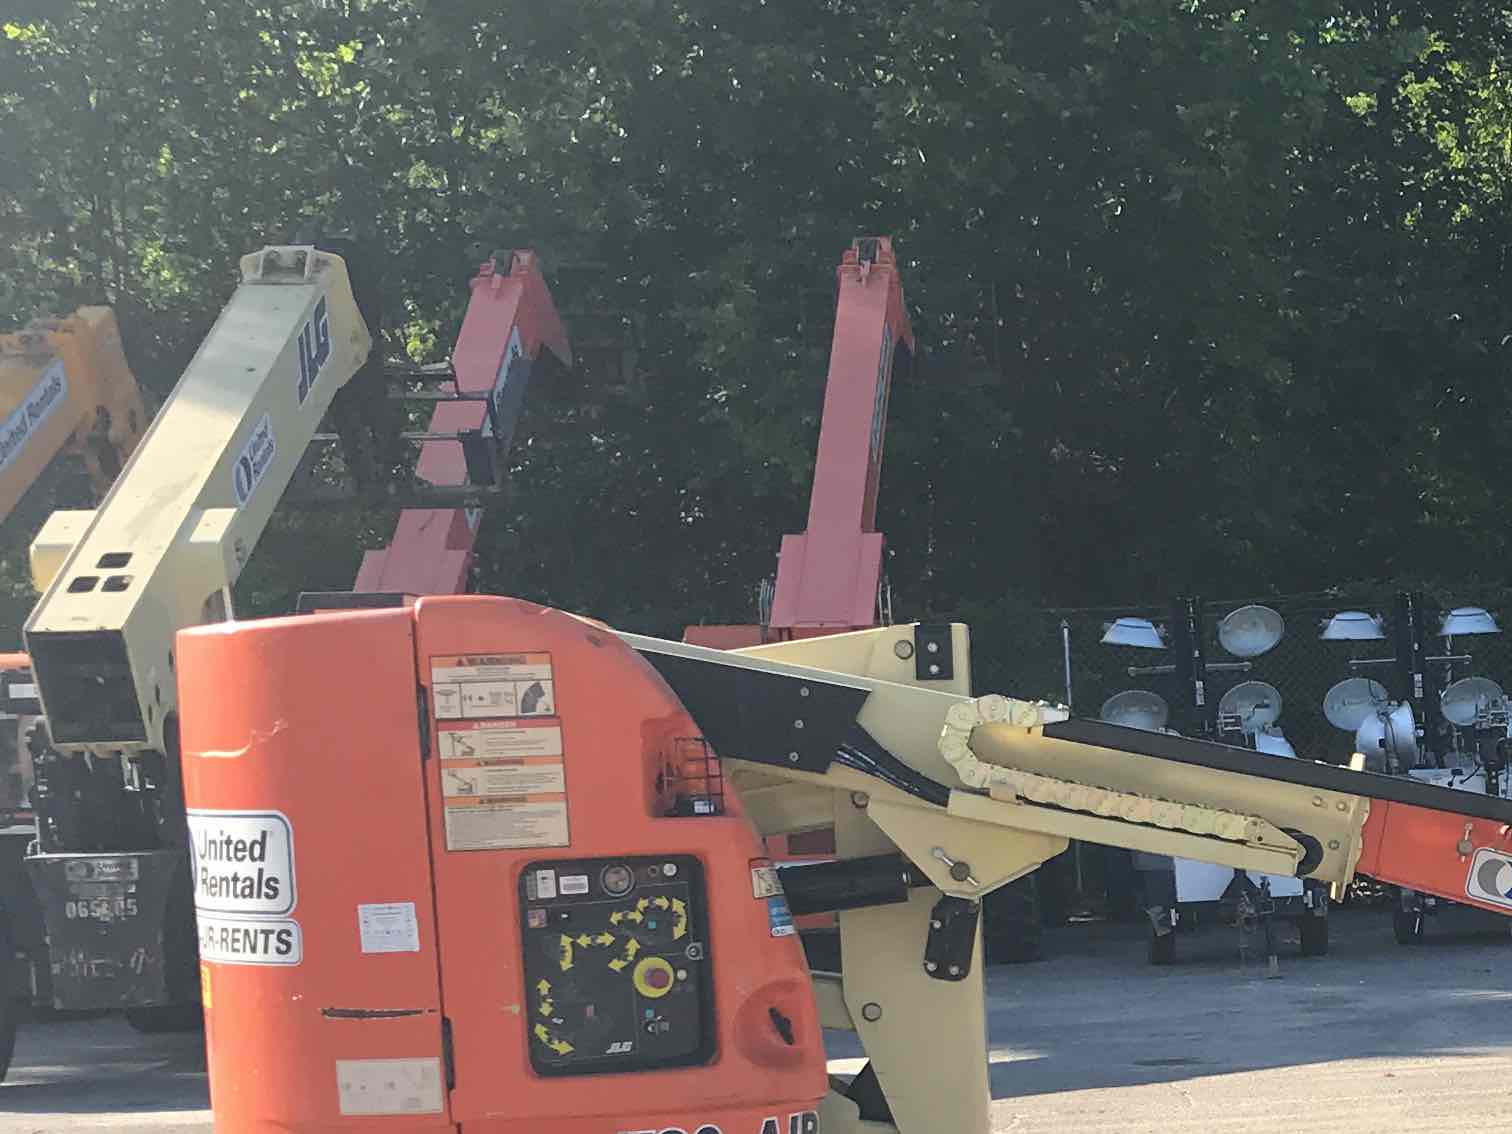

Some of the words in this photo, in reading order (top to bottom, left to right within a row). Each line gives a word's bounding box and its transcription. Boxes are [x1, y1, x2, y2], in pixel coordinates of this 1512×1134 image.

[298, 296, 330, 404] JLG
[199, 829, 268, 863] United
[201, 867, 281, 900] Rentals
